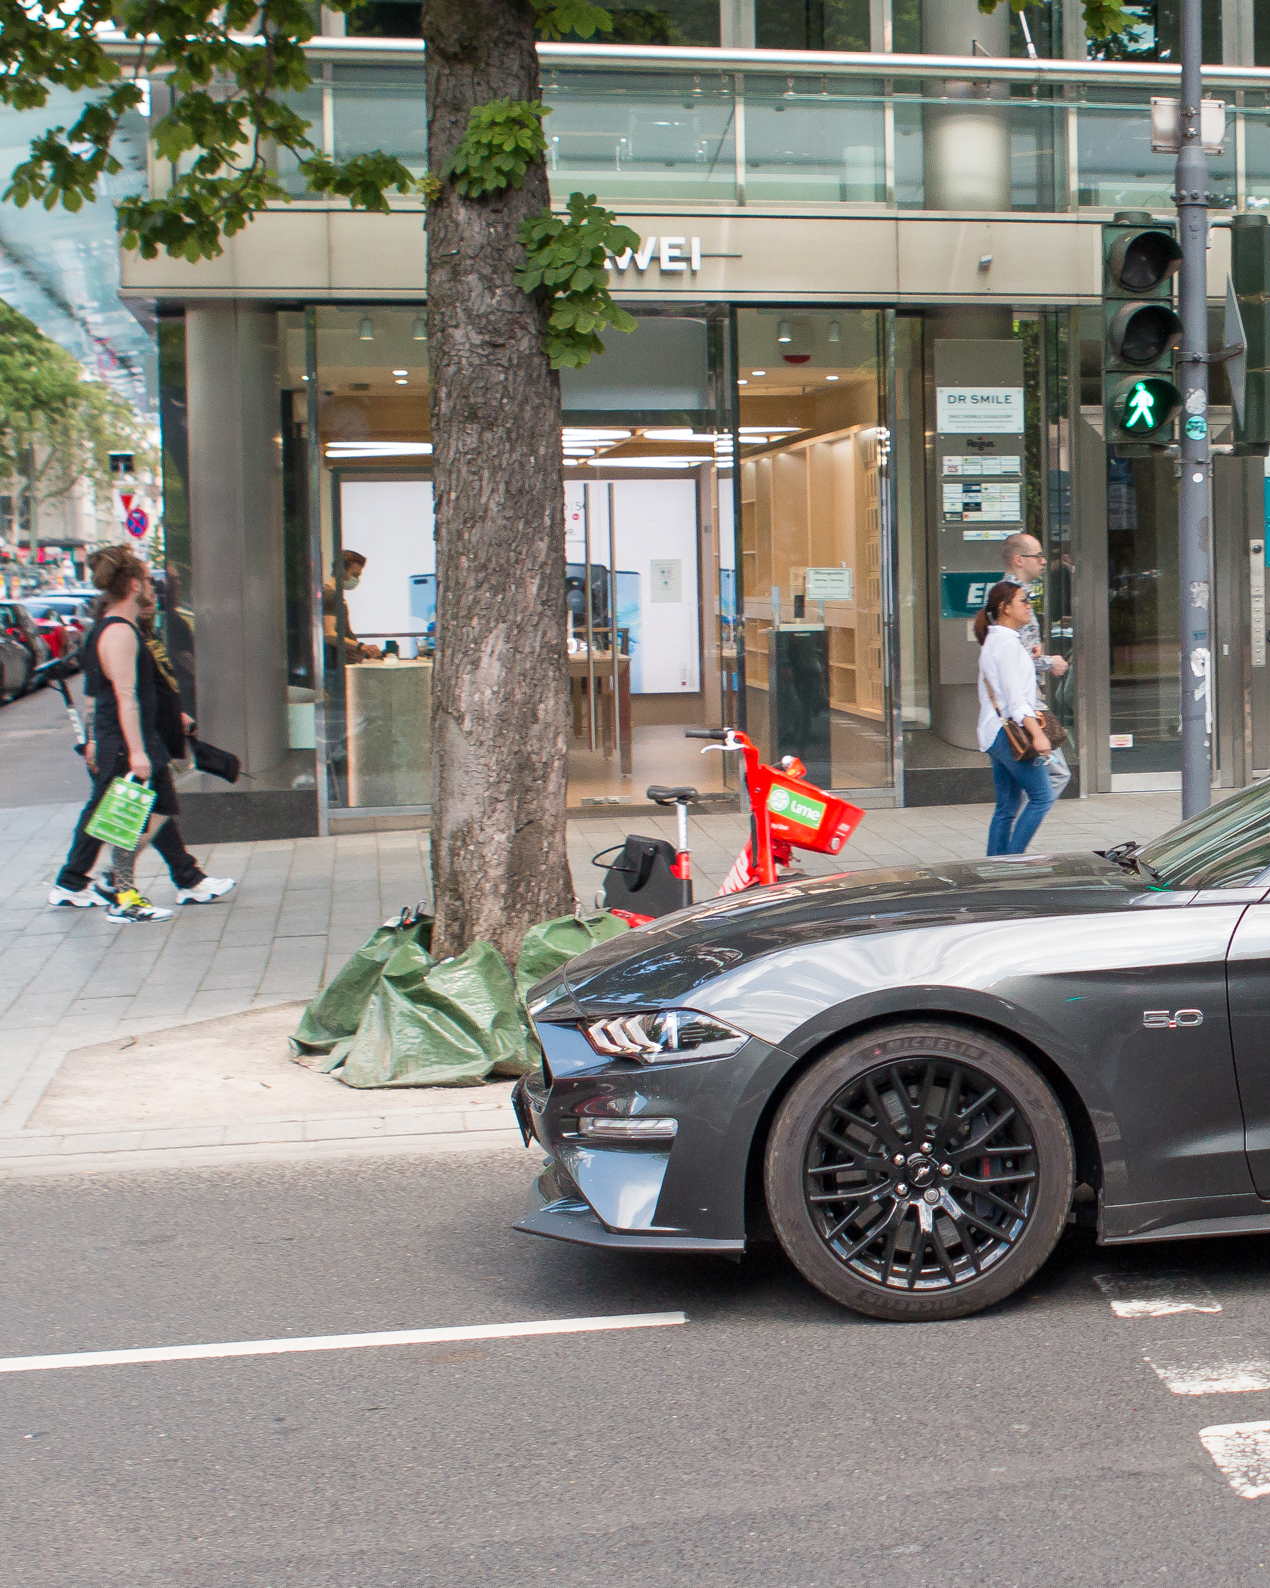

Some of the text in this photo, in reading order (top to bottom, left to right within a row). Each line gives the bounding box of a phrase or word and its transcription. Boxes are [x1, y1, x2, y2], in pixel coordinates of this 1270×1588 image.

[604, 237, 701, 270] WEI
[947, 394, 1012, 404] DR SMILE
[1143, 1009, 1204, 1029] 5.0
